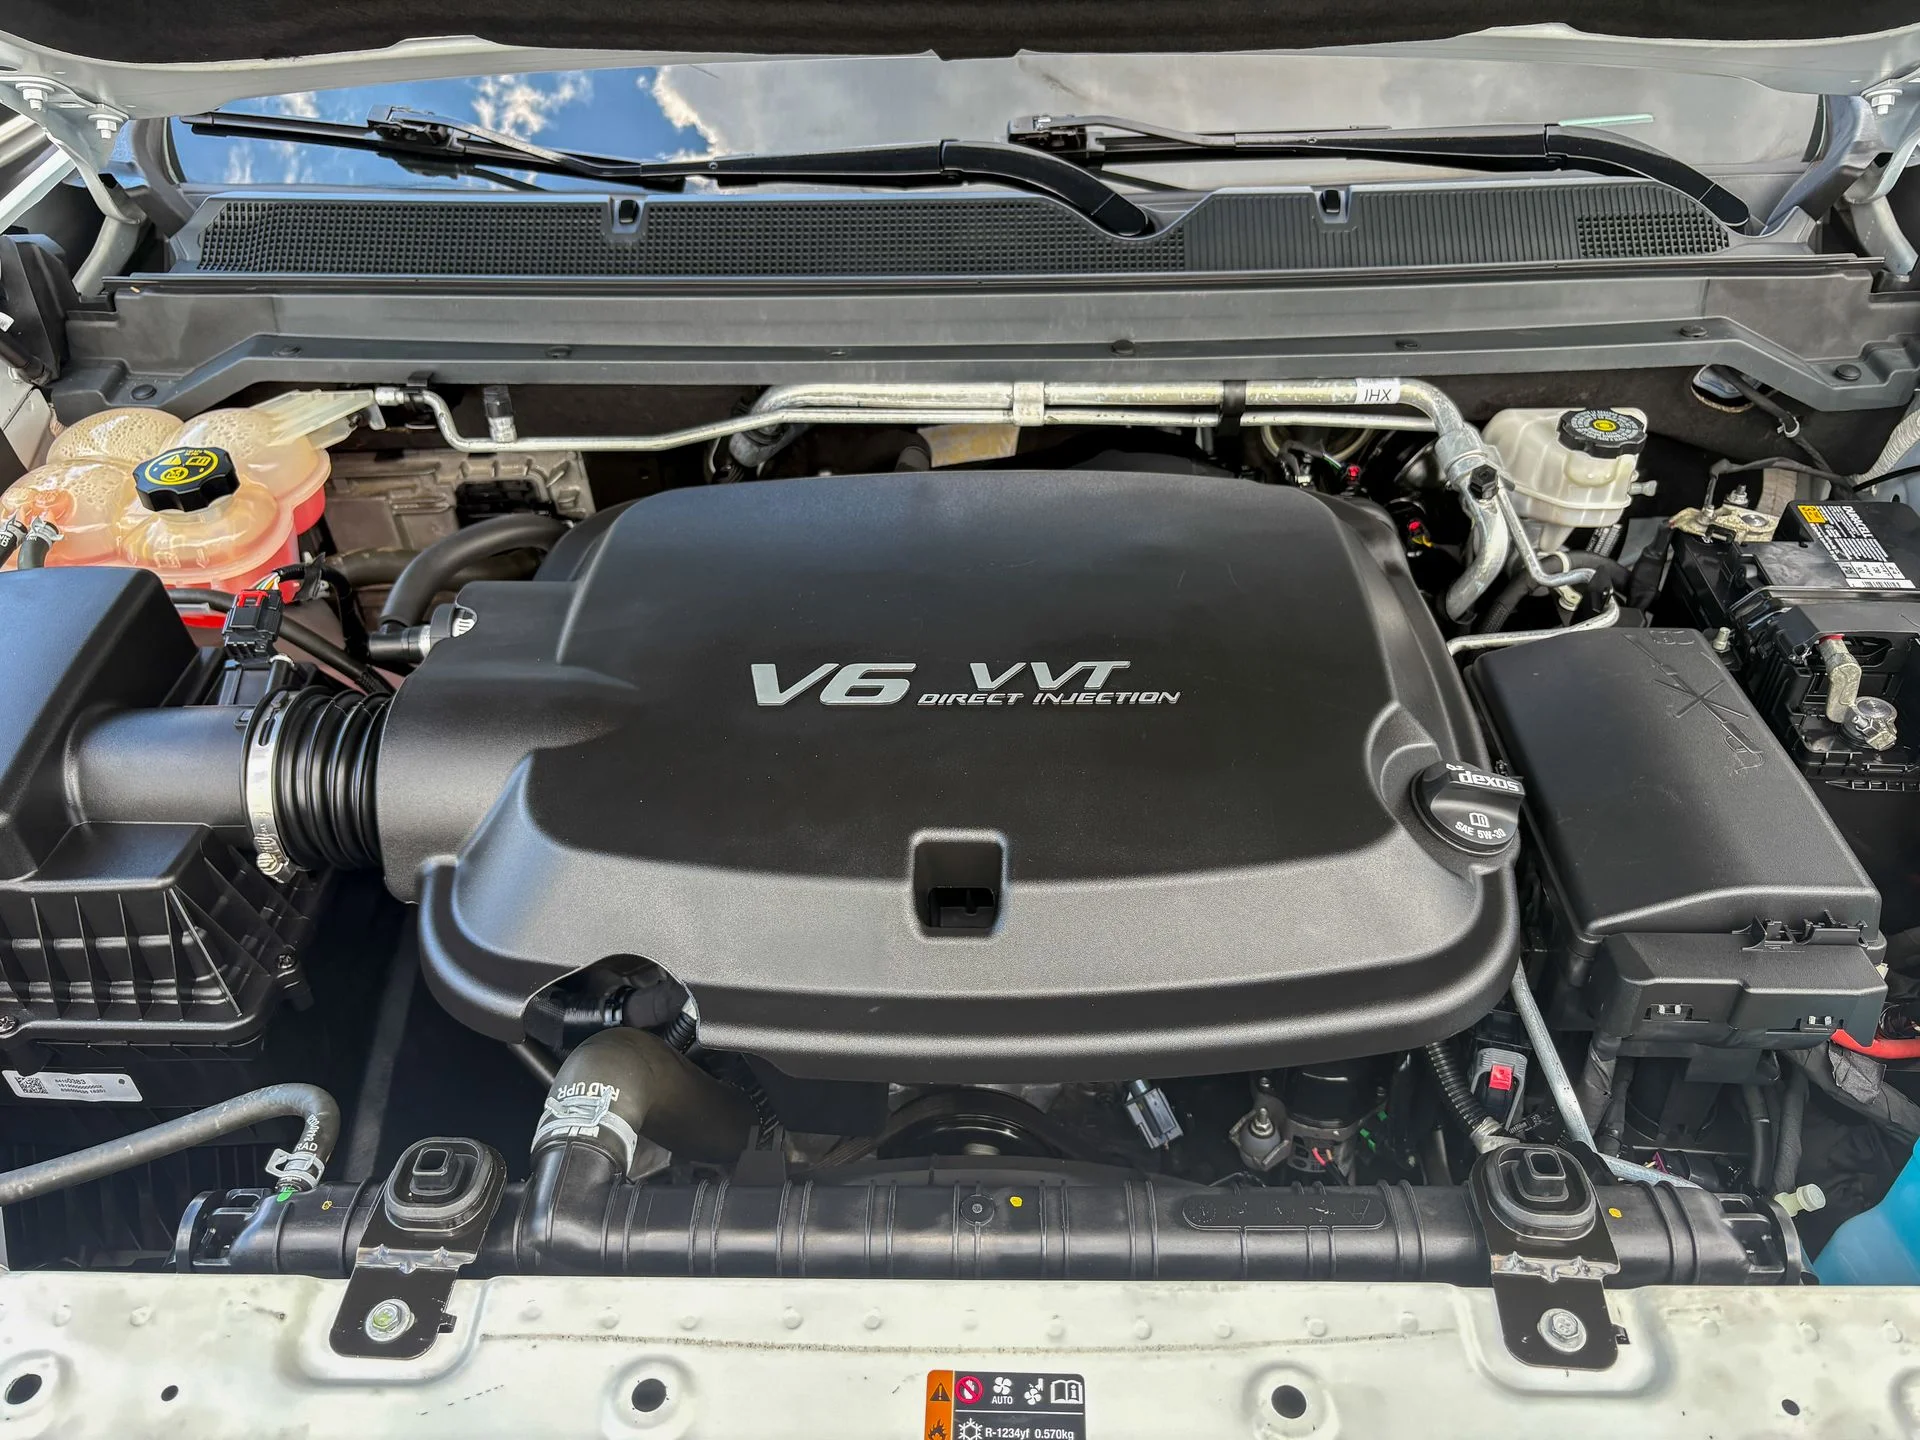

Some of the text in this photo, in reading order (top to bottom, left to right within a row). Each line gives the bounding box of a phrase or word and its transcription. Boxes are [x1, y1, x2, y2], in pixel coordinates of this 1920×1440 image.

[1841, 505, 1875, 539] DURACELL
[750, 660, 1131, 706] V6 VVT
[917, 690, 1182, 706] DIRECT INJECTION
[1458, 770, 1520, 792] dexos
[1454, 821, 1507, 840] SAE 5W-30
[557, 1081, 586, 1100] UPR
[991, 1395, 1014, 1405] AUTO
[984, 1427, 1075, 1440] R-1234yf 0.570kg
